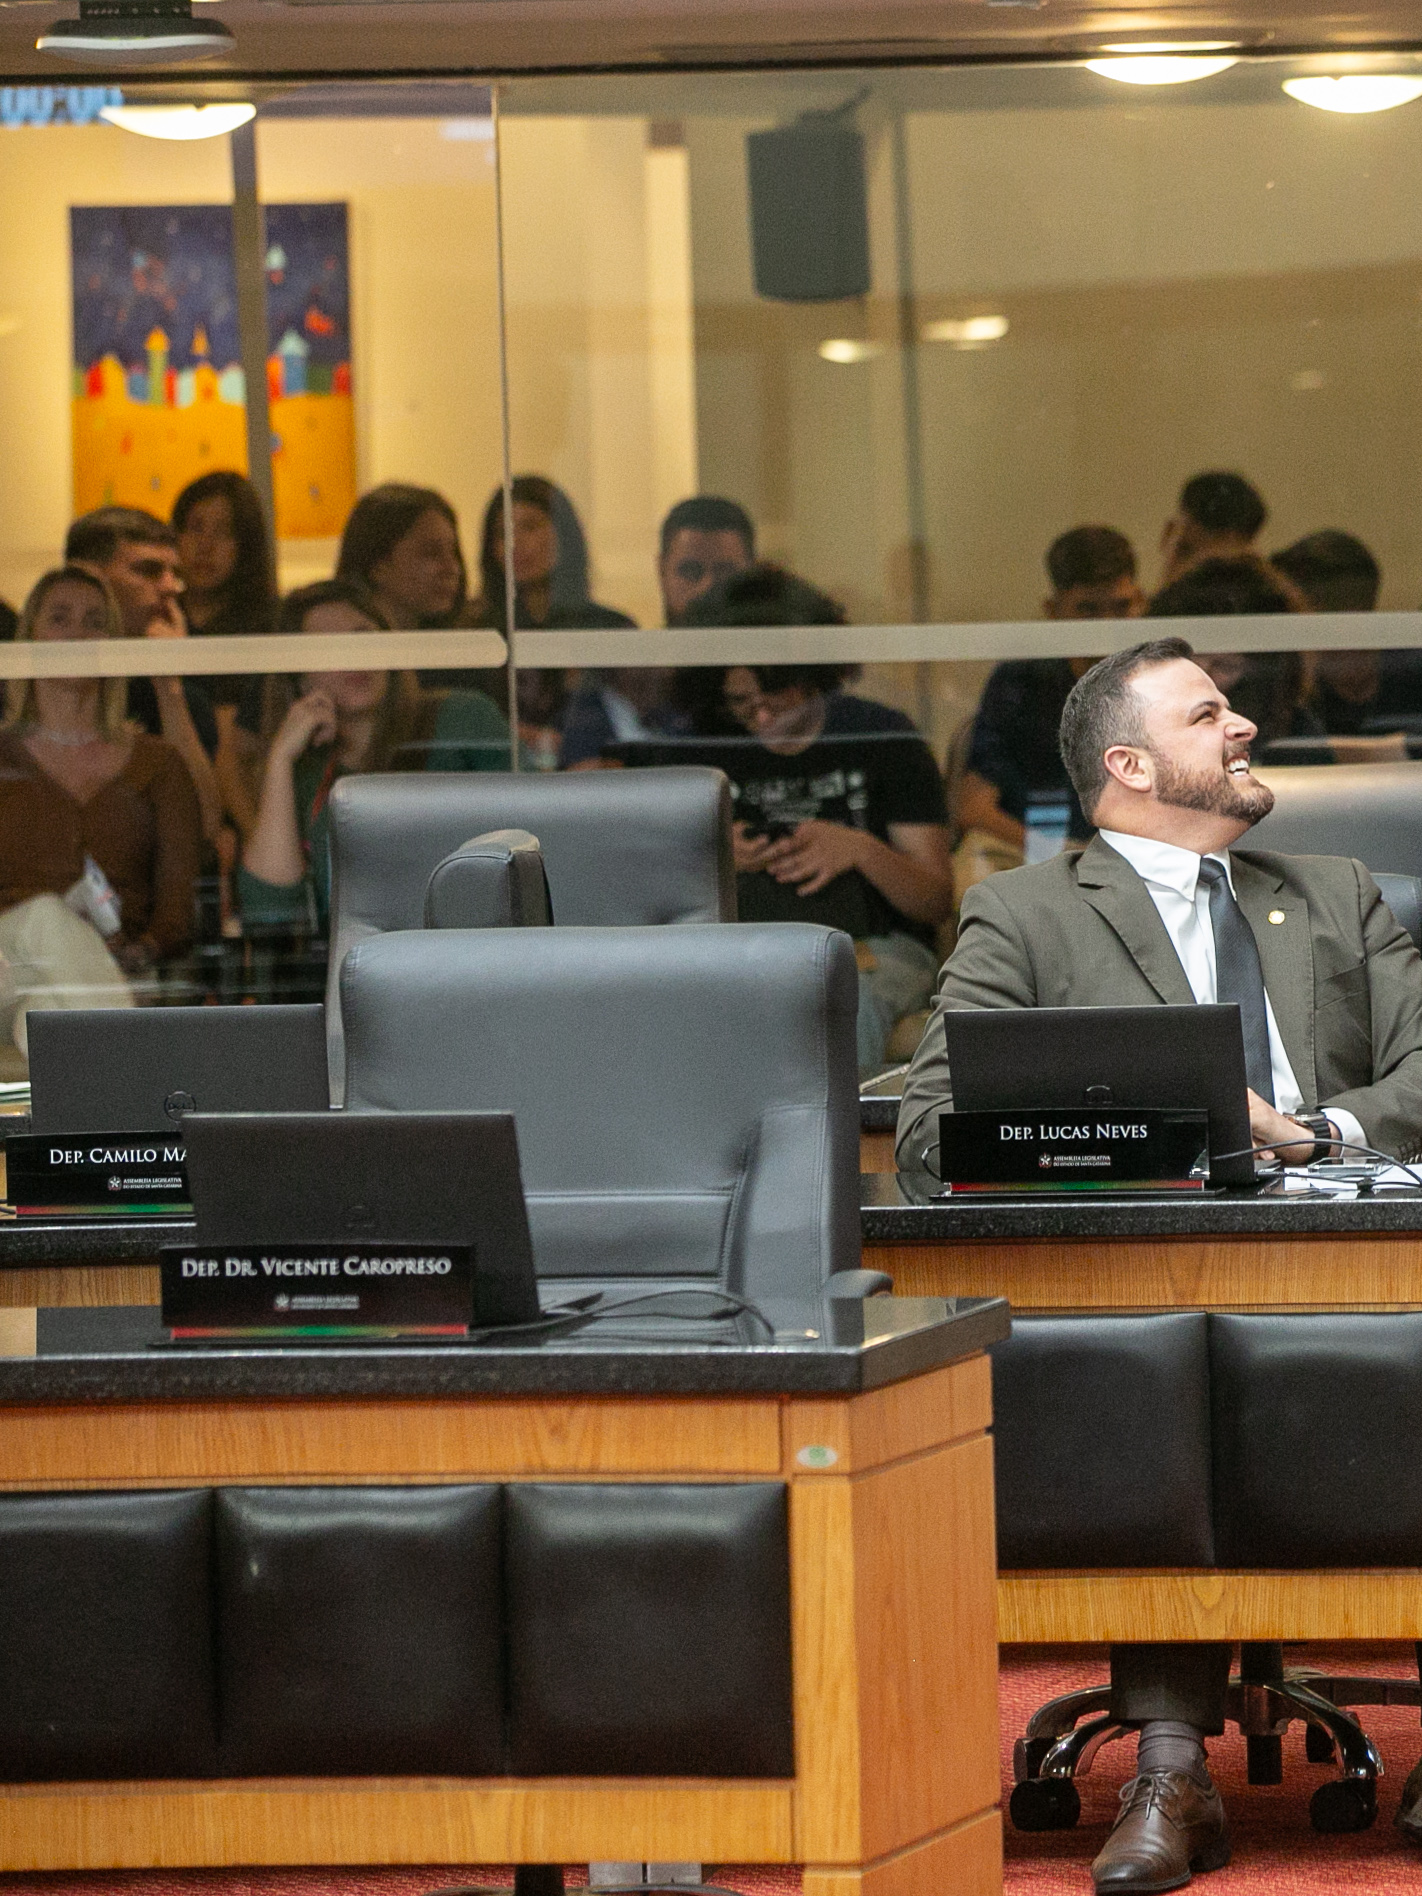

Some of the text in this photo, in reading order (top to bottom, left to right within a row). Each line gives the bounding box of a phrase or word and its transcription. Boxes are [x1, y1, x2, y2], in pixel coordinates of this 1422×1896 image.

[1000, 1123, 1148, 1141] DEP. LUCAS NEVES
[50, 1149, 84, 1165] DEP.
[90, 1147, 157, 1164] CAMILO
[181, 1255, 452, 1277] DEP. DR. VICENTE CAROPRESO
